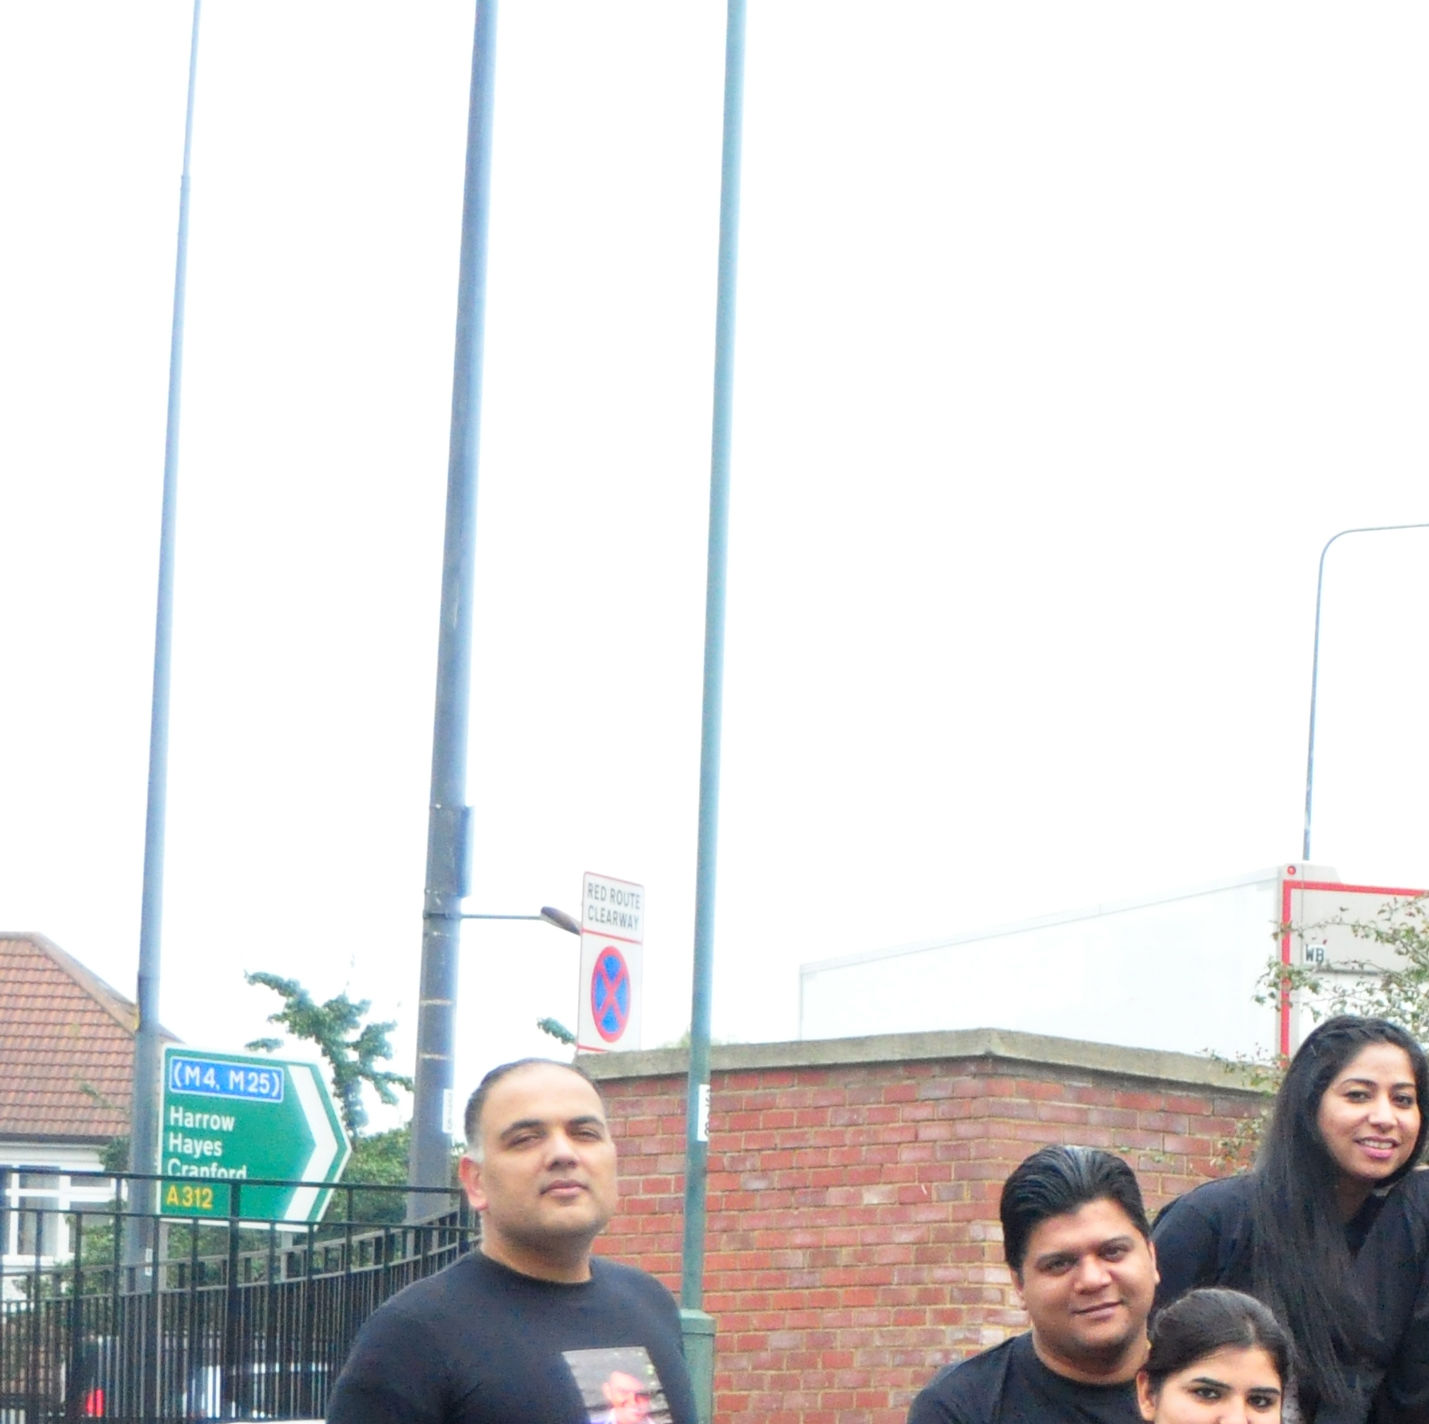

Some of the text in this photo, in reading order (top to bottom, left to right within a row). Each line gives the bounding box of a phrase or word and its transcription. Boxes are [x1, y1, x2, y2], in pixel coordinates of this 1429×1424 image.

[588, 883, 640, 909] RED ROUTE
[587, 905, 640, 930] CLEARWAY
[169, 1105, 235, 1132] Harrow
[168, 1132, 223, 1159] Hayes
[167, 1158, 248, 1180] Cranford
